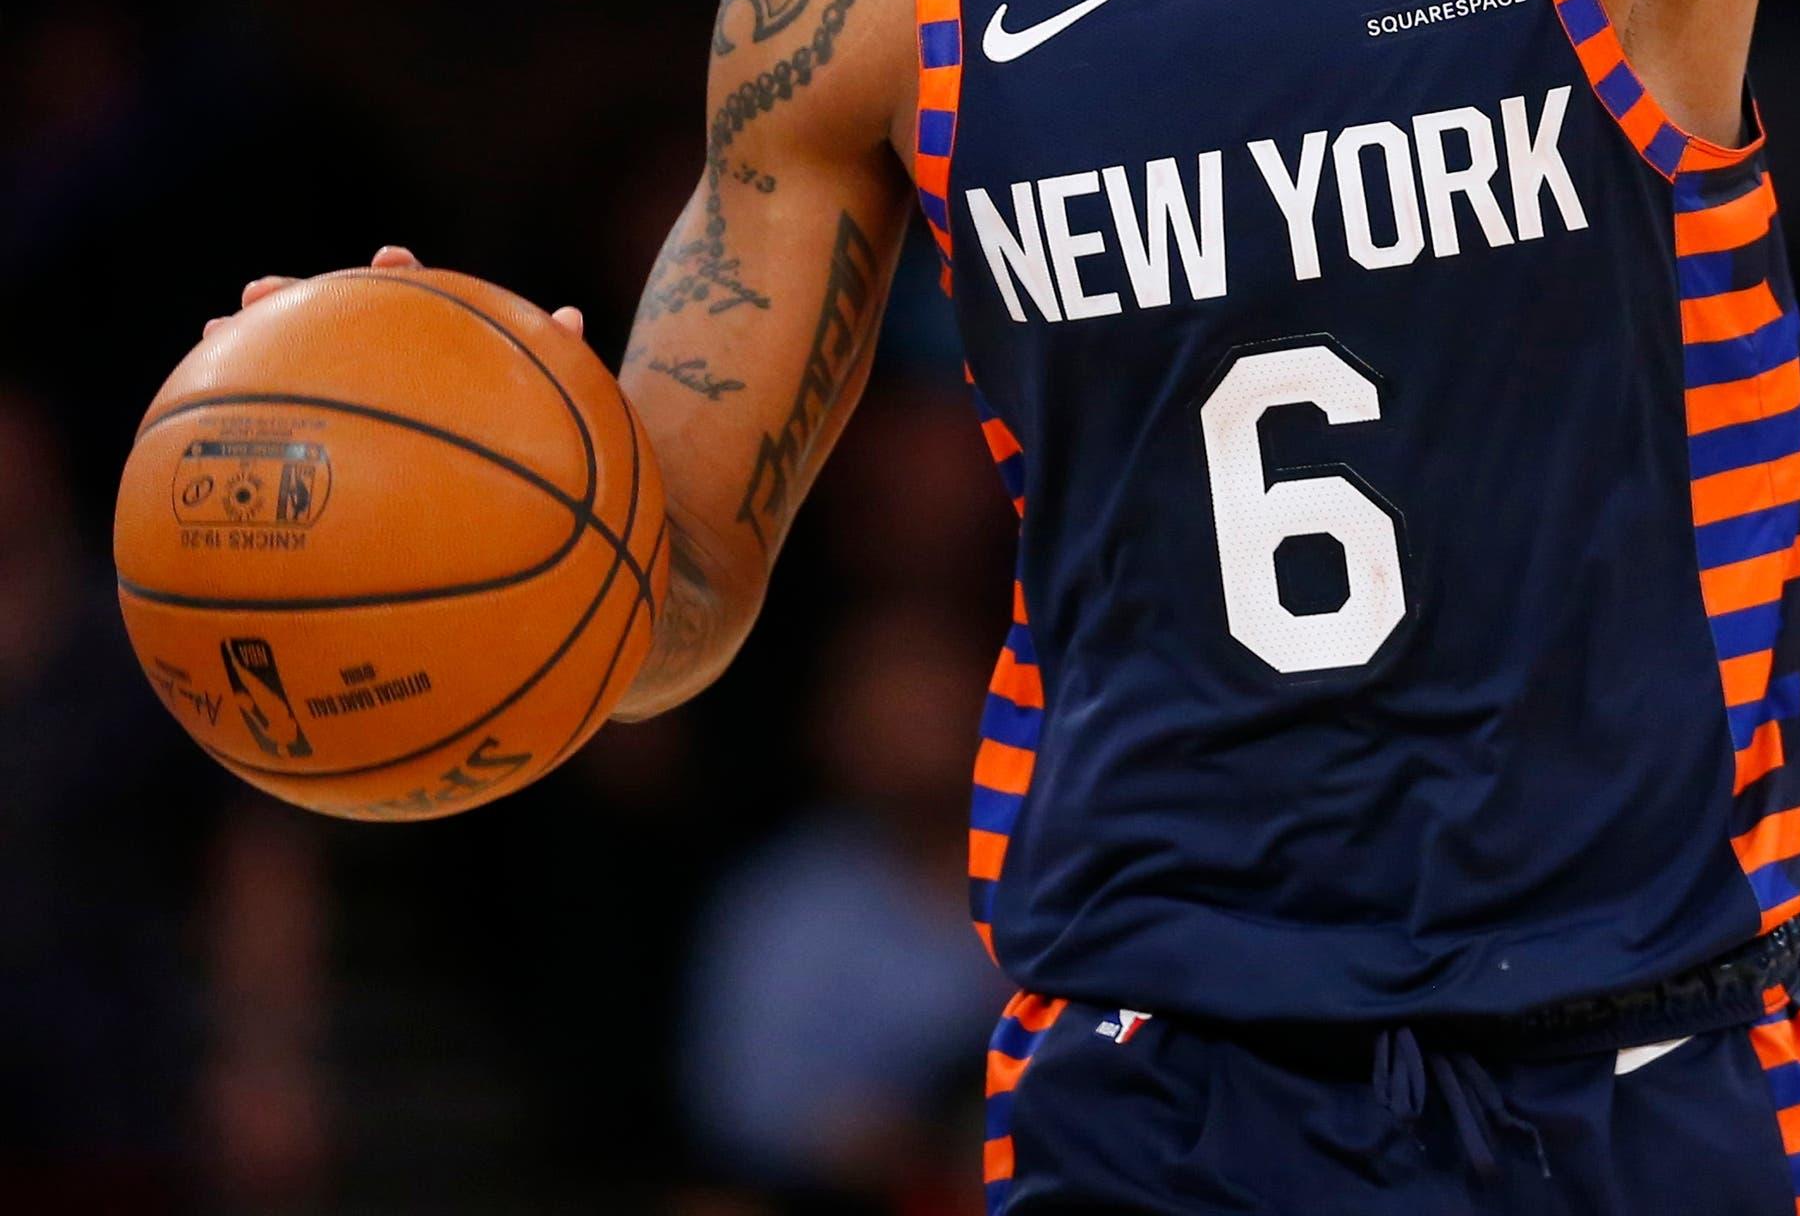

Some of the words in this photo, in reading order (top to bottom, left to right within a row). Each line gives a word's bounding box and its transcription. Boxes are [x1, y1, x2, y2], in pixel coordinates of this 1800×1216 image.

[964, 148, 1229, 324] NEW
[1246, 84, 1590, 282] YORK
[229, 530, 307, 552] KNICKS
[1199, 344, 1409, 674] 6
[237, 643, 271, 668] NBA
